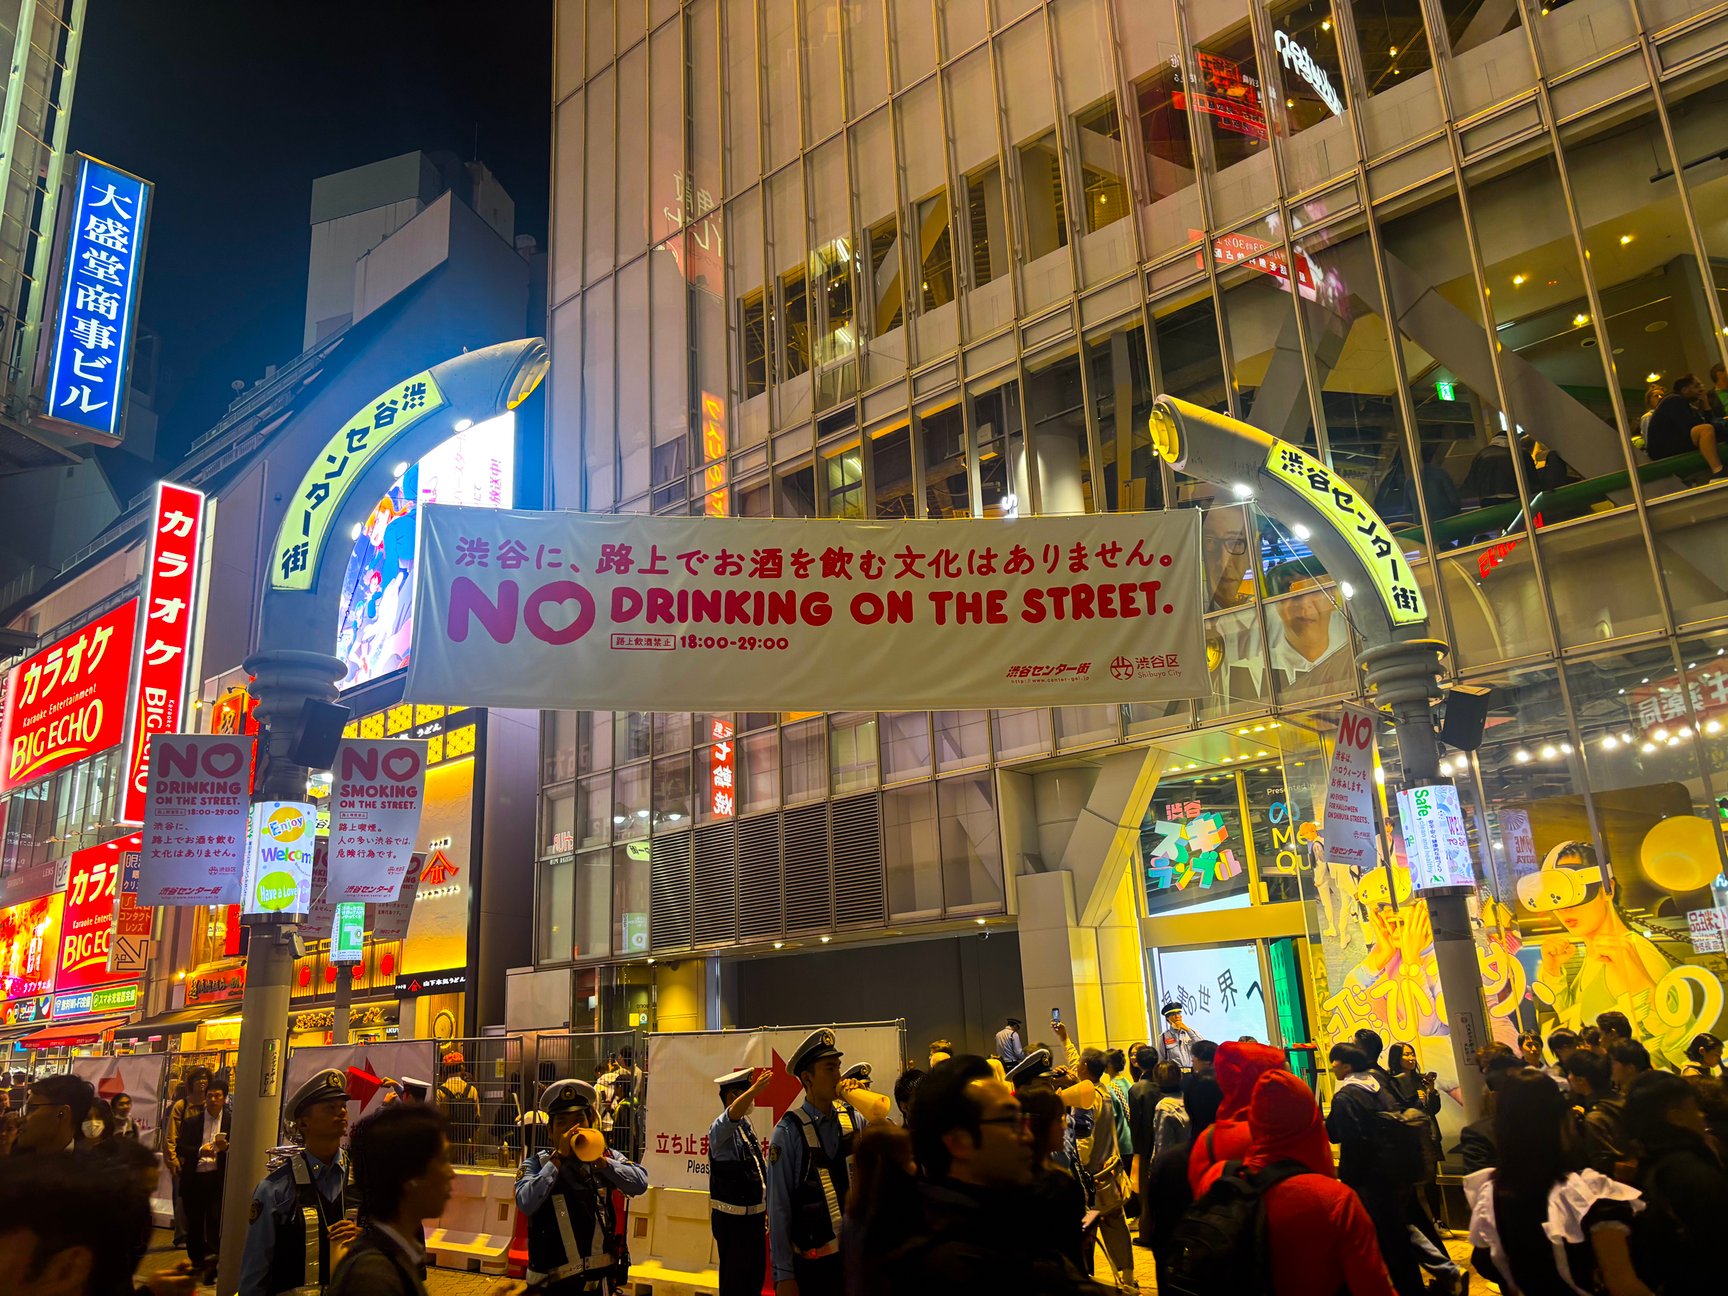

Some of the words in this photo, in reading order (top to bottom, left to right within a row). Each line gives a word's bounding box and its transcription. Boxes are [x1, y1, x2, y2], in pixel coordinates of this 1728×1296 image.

[60, 183, 133, 414] 大盛堂商事ビル
[281, 381, 427, 580] 渋谷センター街
[1280, 449, 1419, 614] 渋谷センター街
[145, 510, 195, 666] カラオケ
[447, 576, 595, 645] NO
[610, 586, 832, 626] DRINKING
[850, 590, 914, 625] ON
[928, 590, 1008, 625] THE
[1021, 580, 1174, 624] STREET.
[615, 636, 672, 648] 路上飲酒禁止
[680, 634, 789, 651] 18:00-29:00
[19, 625, 114, 710] カラオケ
[1006, 662, 1092, 678] 渋谷センター街
[1135, 654, 1180, 670] 渋谷区
[1137, 671, 1166, 680] Shibuya
[1168, 669, 1182, 678] City
[22, 709, 48, 729] Karaoke
[48, 683, 97, 715] Entertainment
[145, 686, 167, 729] BIG
[166, 699, 175, 728] Karaoke
[9, 727, 46, 779] BIG
[47, 698, 104, 750] ECHO
[1339, 711, 1372, 750] NO
[157, 742, 244, 779] NO
[341, 746, 420, 782] NO
[1333, 766, 1367, 781] ハロウィーンを
[155, 781, 241, 795] DRINKING
[340, 784, 418, 798] SMOKING
[1331, 778, 1364, 794] お休みします。
[155, 797, 174, 806] ON
[176, 797, 197, 806] THE
[200, 796, 240, 806] STREET.
[340, 800, 355, 809] ON
[359, 801, 377, 809] THE
[380, 801, 416, 810] STREET.
[1414, 789, 1432, 820] Safe,
[187, 808, 240, 816] 18:00-29:00
[1165, 799, 1202, 821] 渋谷
[153, 822, 189, 831] 渋谷に、
[269, 816, 303, 838] Enjoy
[338, 823, 382, 832] 路上喫煙。
[152, 835, 236, 845] 路上でお酒を飲む
[151, 849, 236, 859] 文化はありません。
[261, 847, 314, 864] Welcom
[336, 849, 397, 859] 危険行為です。
[124, 881, 138, 891] クリ
[260, 885, 278, 902] Have
[94, 913, 112, 925] Entert
[120, 912, 151, 922] コンタクト
[126, 923, 143, 932] レンズ
[61, 933, 92, 970] BIG
[94, 928, 112, 953] EC
[115, 953, 126, 961] 入口
[656, 1133, 709, 1156] 立ち止ま
[687, 1159, 710, 1174] Pleas
